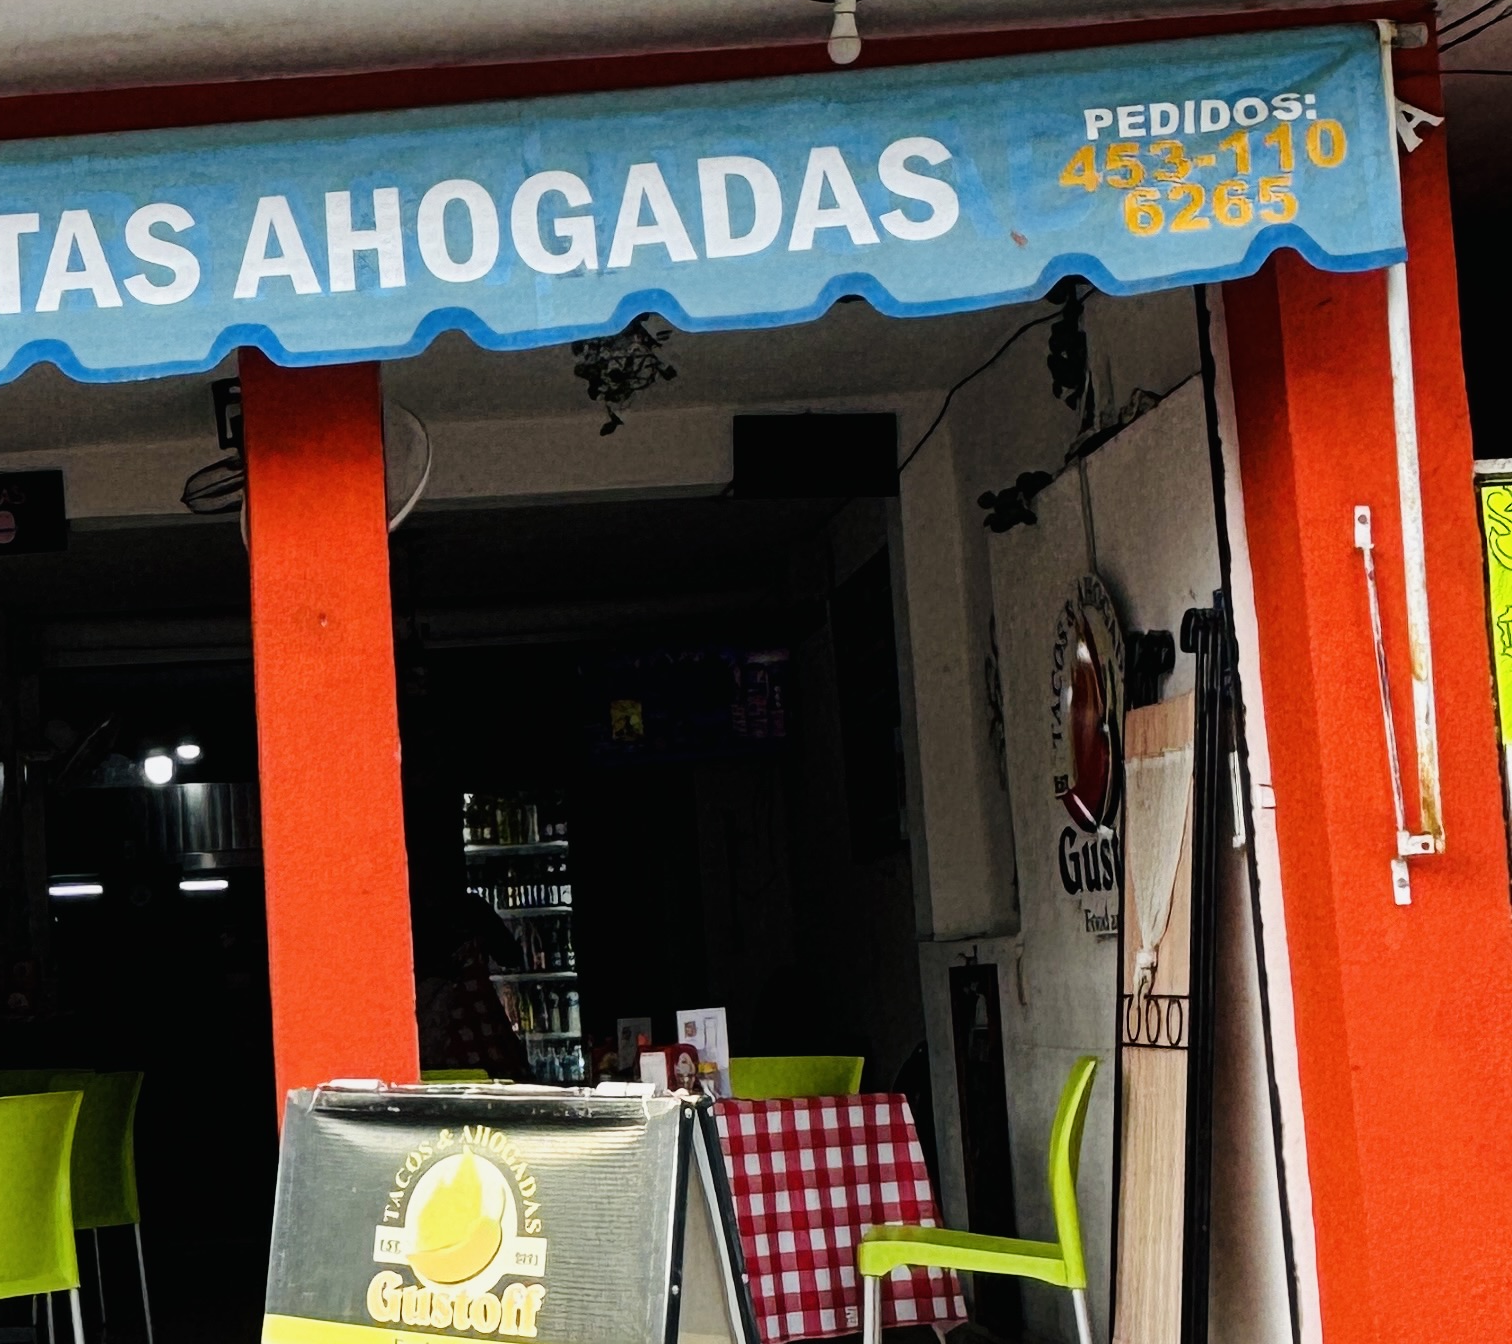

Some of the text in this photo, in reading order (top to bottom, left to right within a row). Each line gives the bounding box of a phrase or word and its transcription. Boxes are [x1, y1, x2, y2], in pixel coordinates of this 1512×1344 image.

[1083, 93, 1316, 140] PEDIDOS:
[1059, 119, 1348, 192] 453-110
[233, 137, 960, 299] AHOGADAS
[1123, 175, 1299, 236] 6265
[383, 1141, 433, 1223] TACOS
[459, 1124, 542, 1234] AHOGADAS
[367, 1270, 546, 1338] Gustoff
